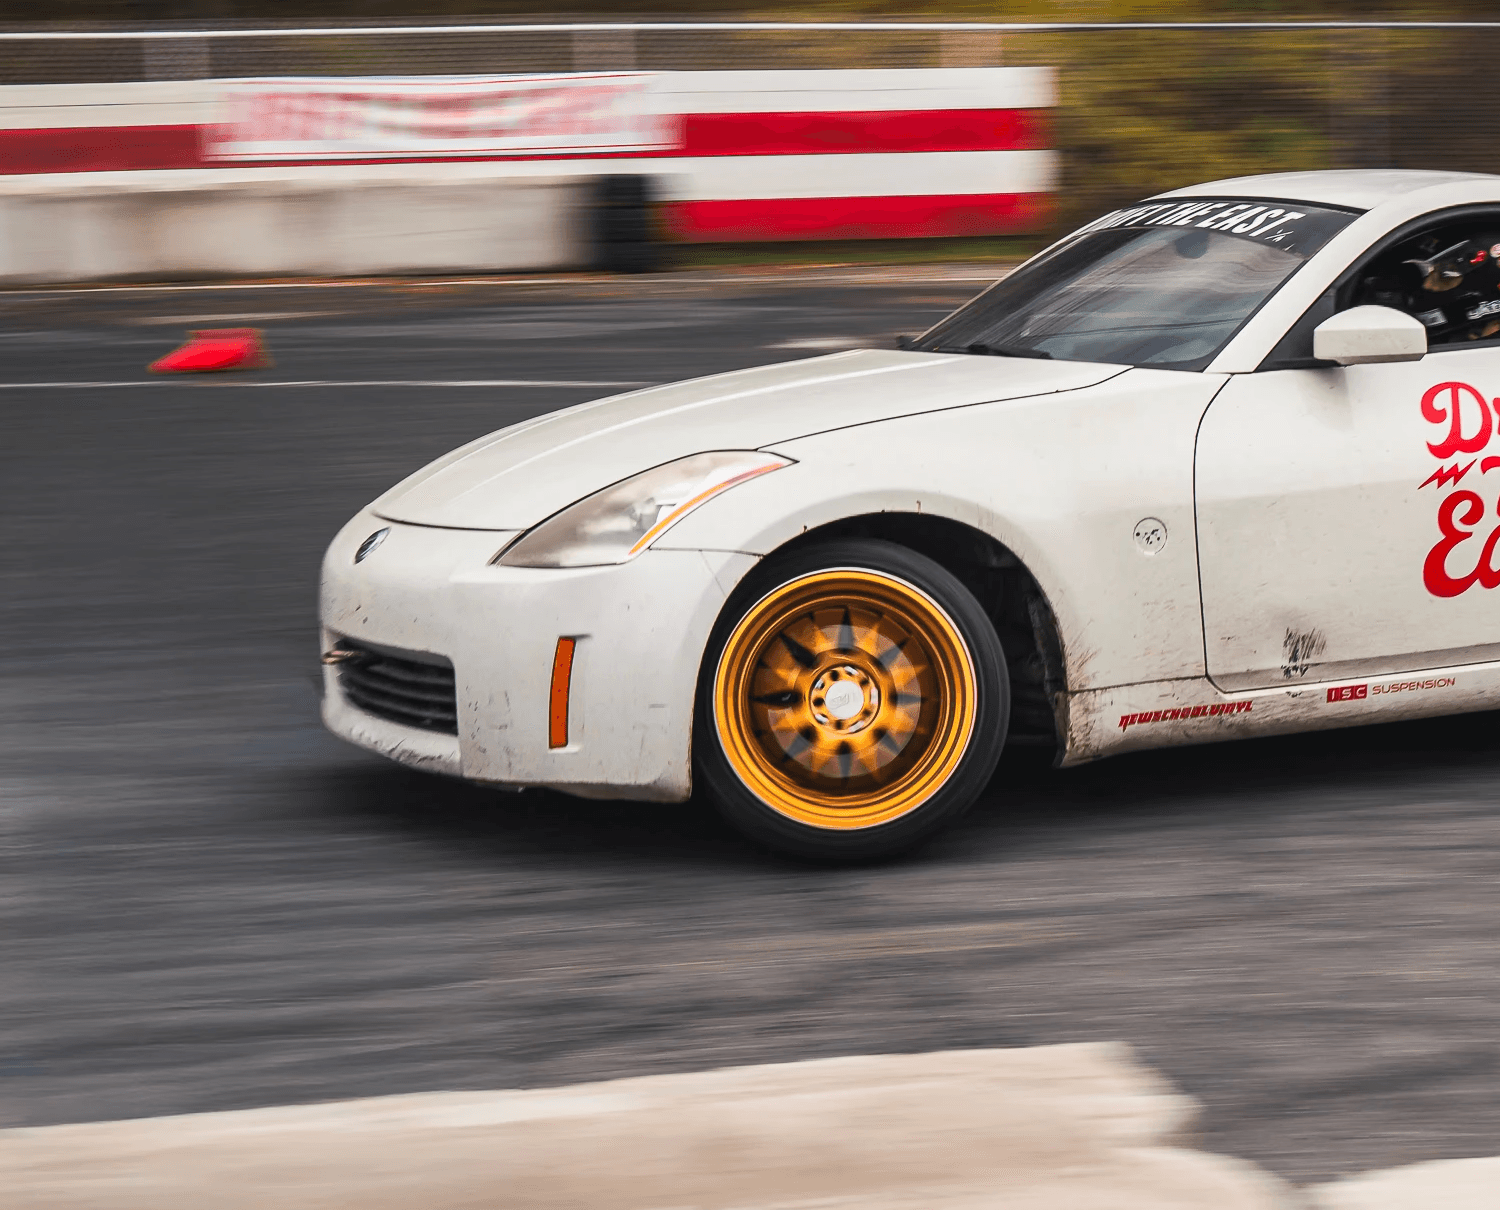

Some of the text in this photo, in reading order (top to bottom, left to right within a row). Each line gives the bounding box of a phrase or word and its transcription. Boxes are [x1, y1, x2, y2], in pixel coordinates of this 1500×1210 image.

[1143, 203, 1230, 226] THE
[1194, 204, 1307, 238] EAST
[1372, 677, 1456, 695] SUSPENSION
